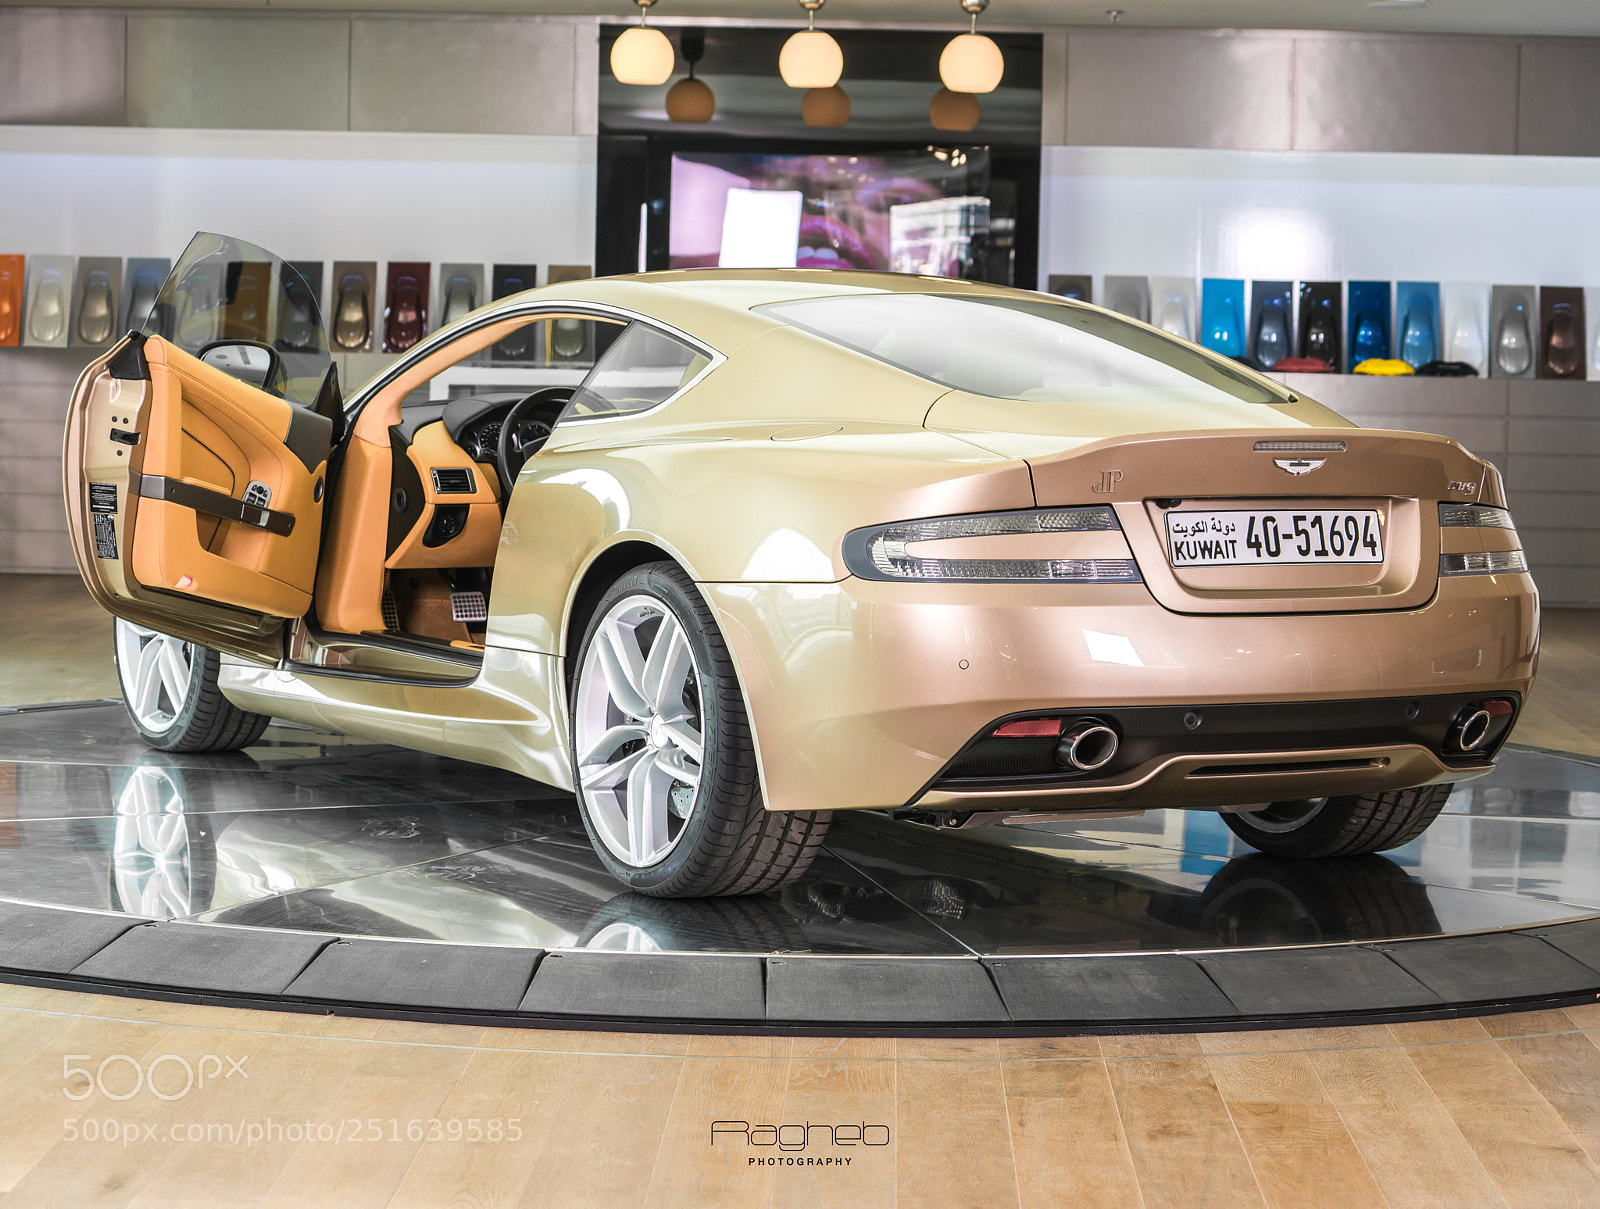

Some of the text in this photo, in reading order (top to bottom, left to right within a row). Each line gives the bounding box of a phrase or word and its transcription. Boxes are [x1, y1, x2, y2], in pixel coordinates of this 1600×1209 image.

[1172, 517, 1236, 537] دولة الكويت
[1246, 515, 1377, 558] 40-51694
[1174, 540, 1237, 561] KUWAIT
